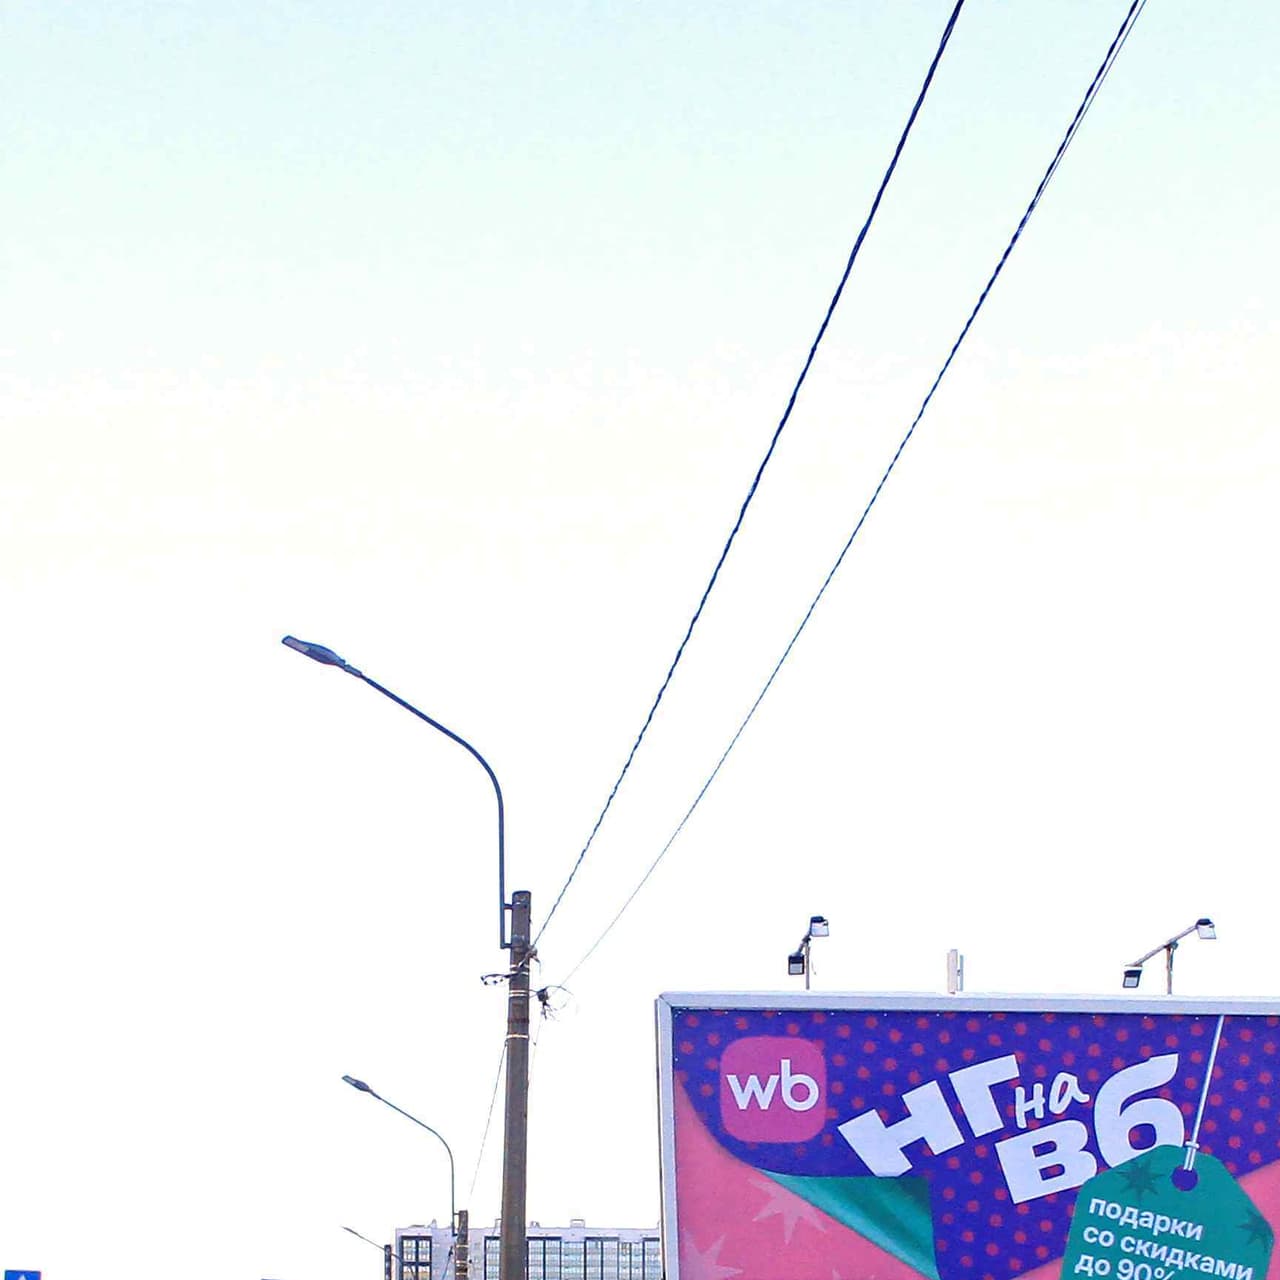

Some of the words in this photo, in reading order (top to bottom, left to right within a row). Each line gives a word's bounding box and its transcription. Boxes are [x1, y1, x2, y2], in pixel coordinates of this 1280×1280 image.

[726, 1058, 820, 1112] wb
[1015, 1071, 1090, 1130] на
[1082, 1226, 1115, 1248] со
[1088, 1197, 1204, 1241] подарки
[1073, 1254, 1112, 1277] до
